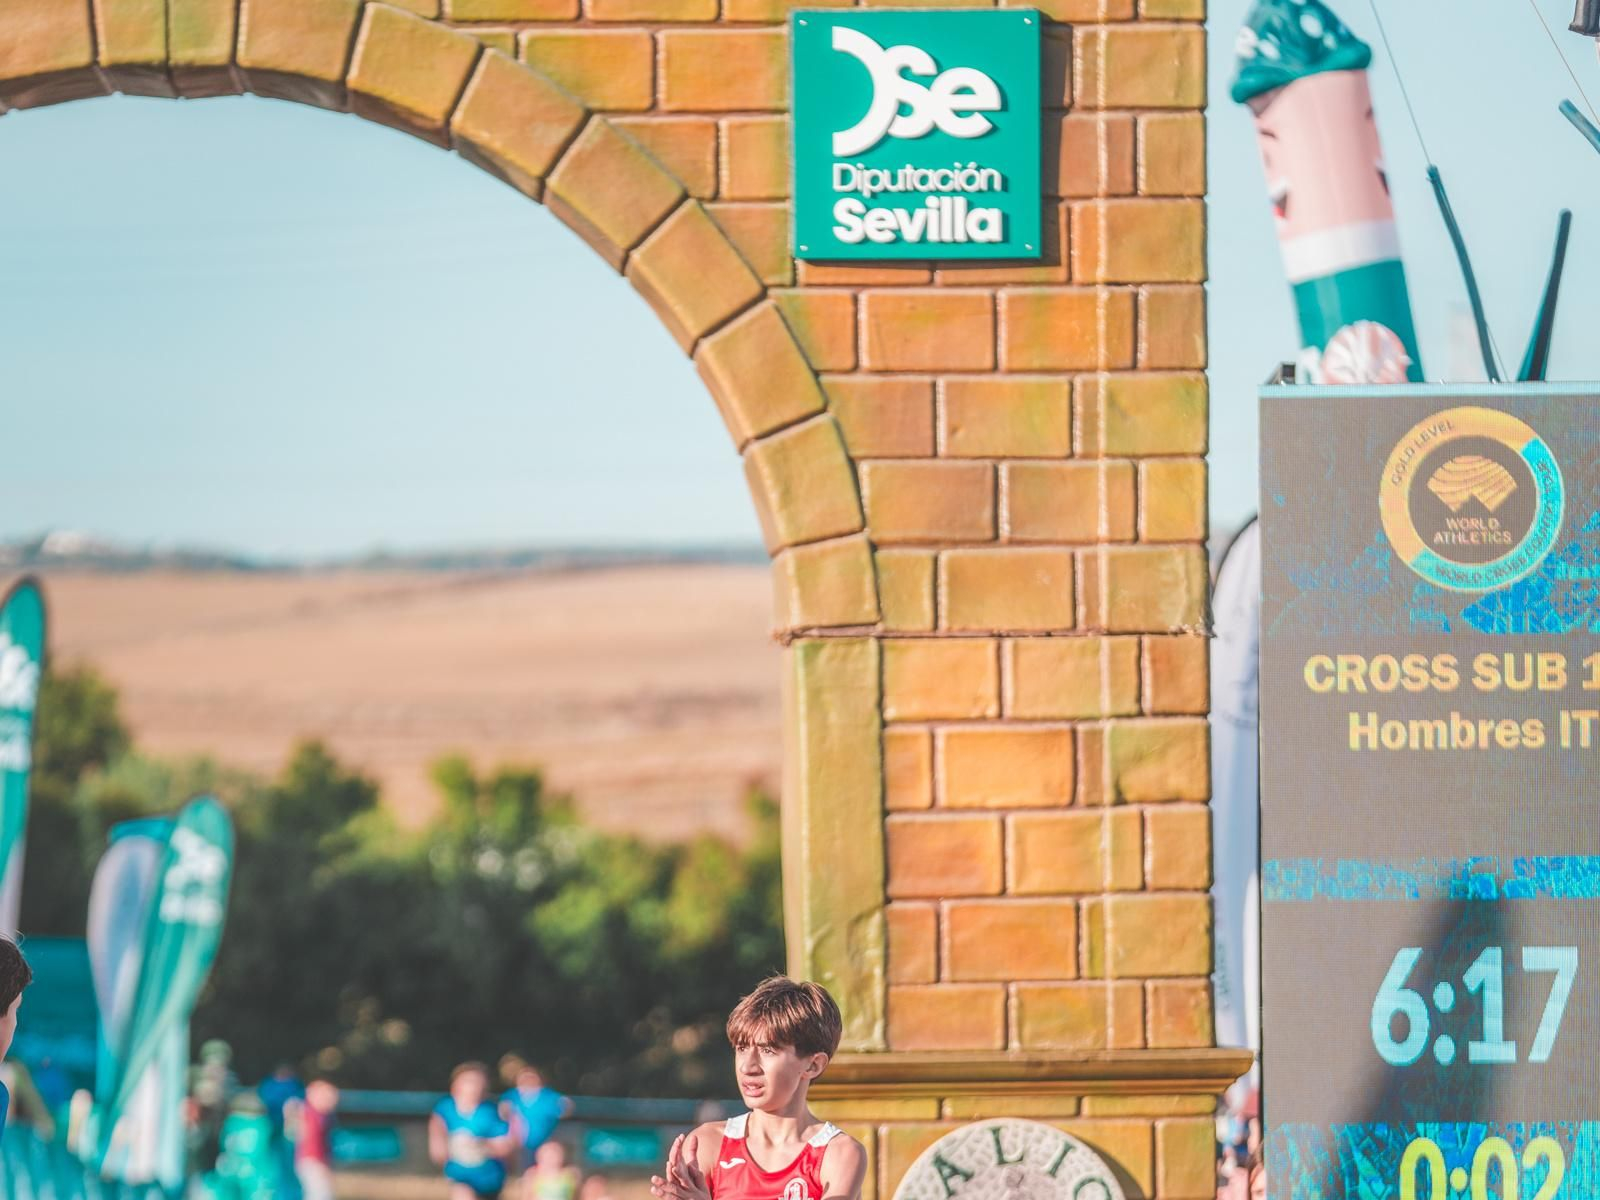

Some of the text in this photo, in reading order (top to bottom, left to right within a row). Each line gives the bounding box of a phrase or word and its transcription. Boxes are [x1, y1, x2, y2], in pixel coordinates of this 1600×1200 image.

[832, 162, 1002, 197] Diputación
[832, 196, 1003, 243] Sevilla
[1391, 419, 1455, 486] GOLD LEVEL
[1434, 531, 1513, 545] ATHLETICS
[1445, 517, 1500, 530] WORLD
[1304, 653, 1460, 692] CROSS
[1472, 652, 1567, 691] SUB
[1349, 709, 1599, 750] Hombres IT
[1371, 946, 1578, 1066] 6:17
